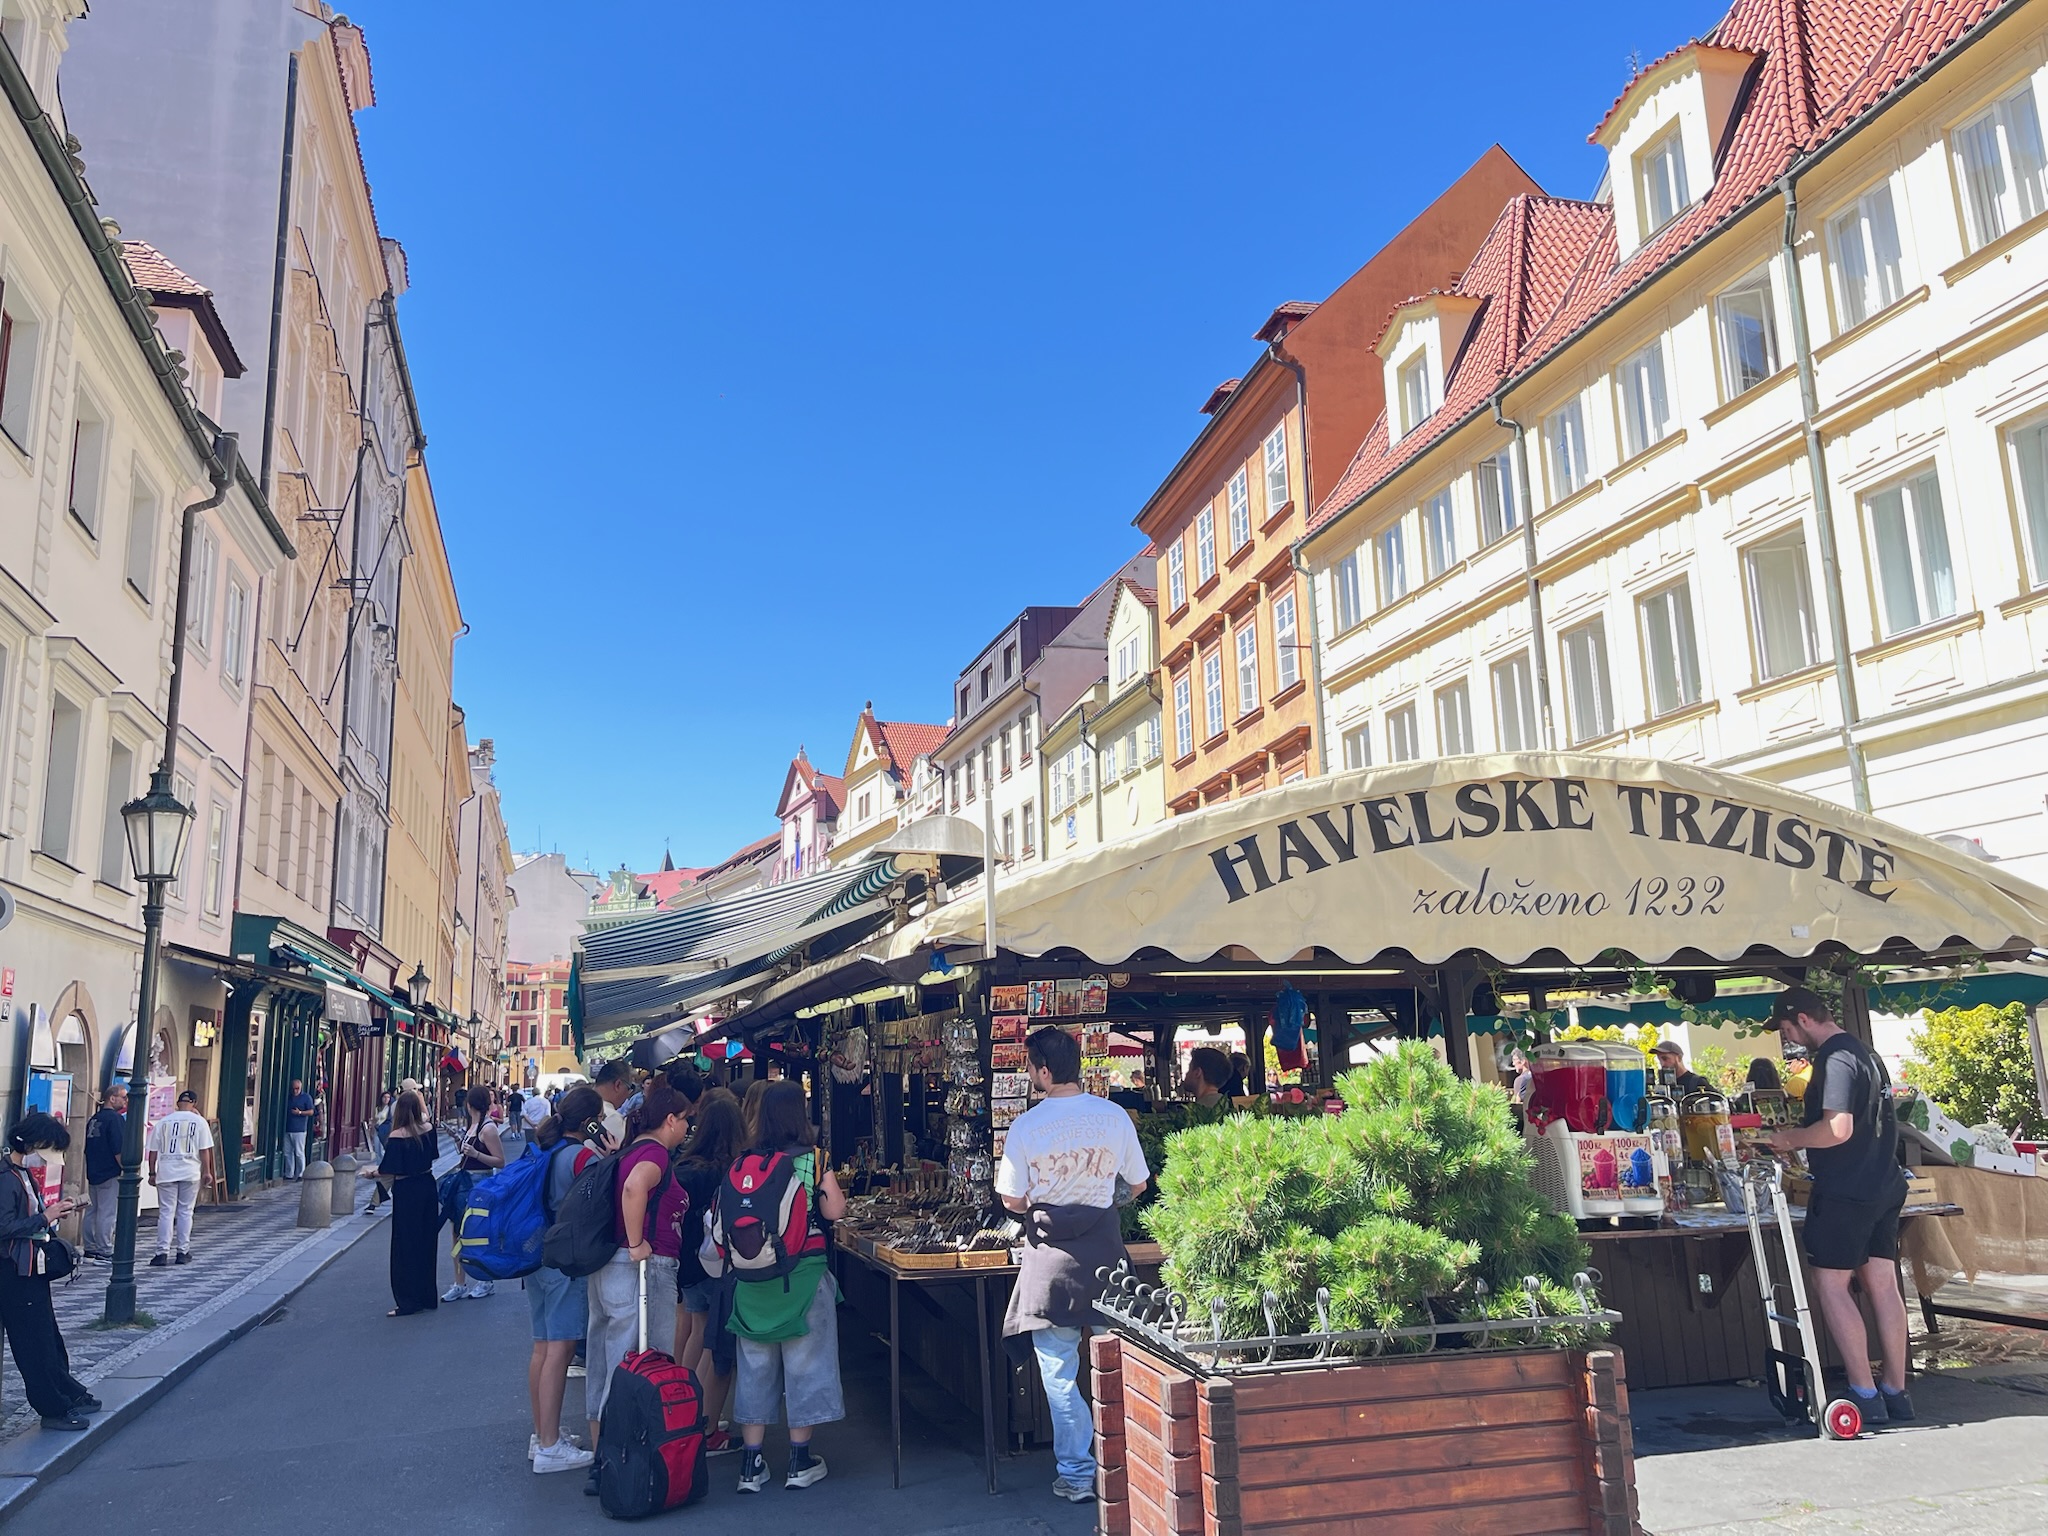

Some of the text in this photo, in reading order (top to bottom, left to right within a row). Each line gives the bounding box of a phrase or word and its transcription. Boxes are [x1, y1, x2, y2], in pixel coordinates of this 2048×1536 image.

[1412, 867, 1725, 917] založeno 1232
[995, 986, 1025, 994] PRAGUE
[1080, 1113, 1120, 1128] SCOTT
[1580, 1140, 1594, 1150] 100
[1617, 1138, 1632, 1148] 100
